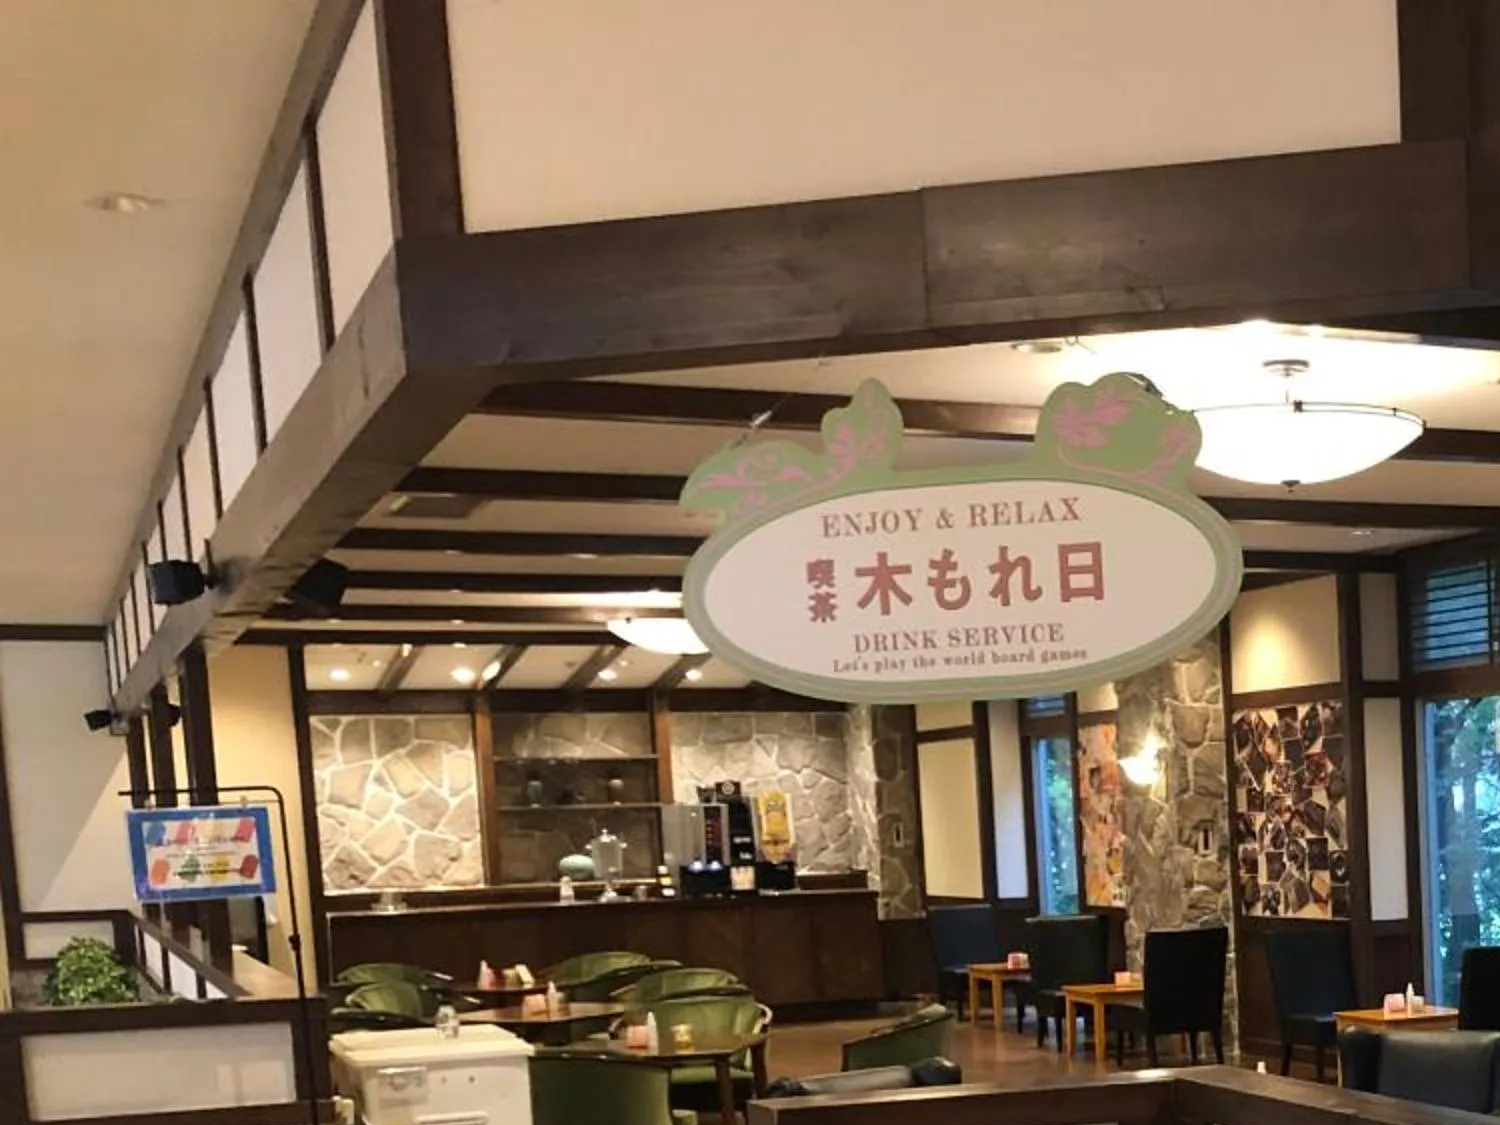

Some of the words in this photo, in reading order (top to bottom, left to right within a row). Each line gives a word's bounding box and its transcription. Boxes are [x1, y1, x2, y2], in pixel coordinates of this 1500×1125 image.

[822, 508, 922, 538] ENJOY
[935, 508, 954, 529] &
[969, 497, 1081, 527] RELAX
[806, 558, 838, 623] 喫茶
[854, 541, 1104, 616] 木もれ日
[854, 628, 938, 654] DRINK
[947, 622, 1065, 648] SERVICE
[833, 657, 869, 673] Let's
[874, 656, 906, 674] play
[912, 653, 937, 669] the
[943, 651, 985, 666] world
[991, 648, 1035, 665] board
[1041, 649, 1088, 664] games
